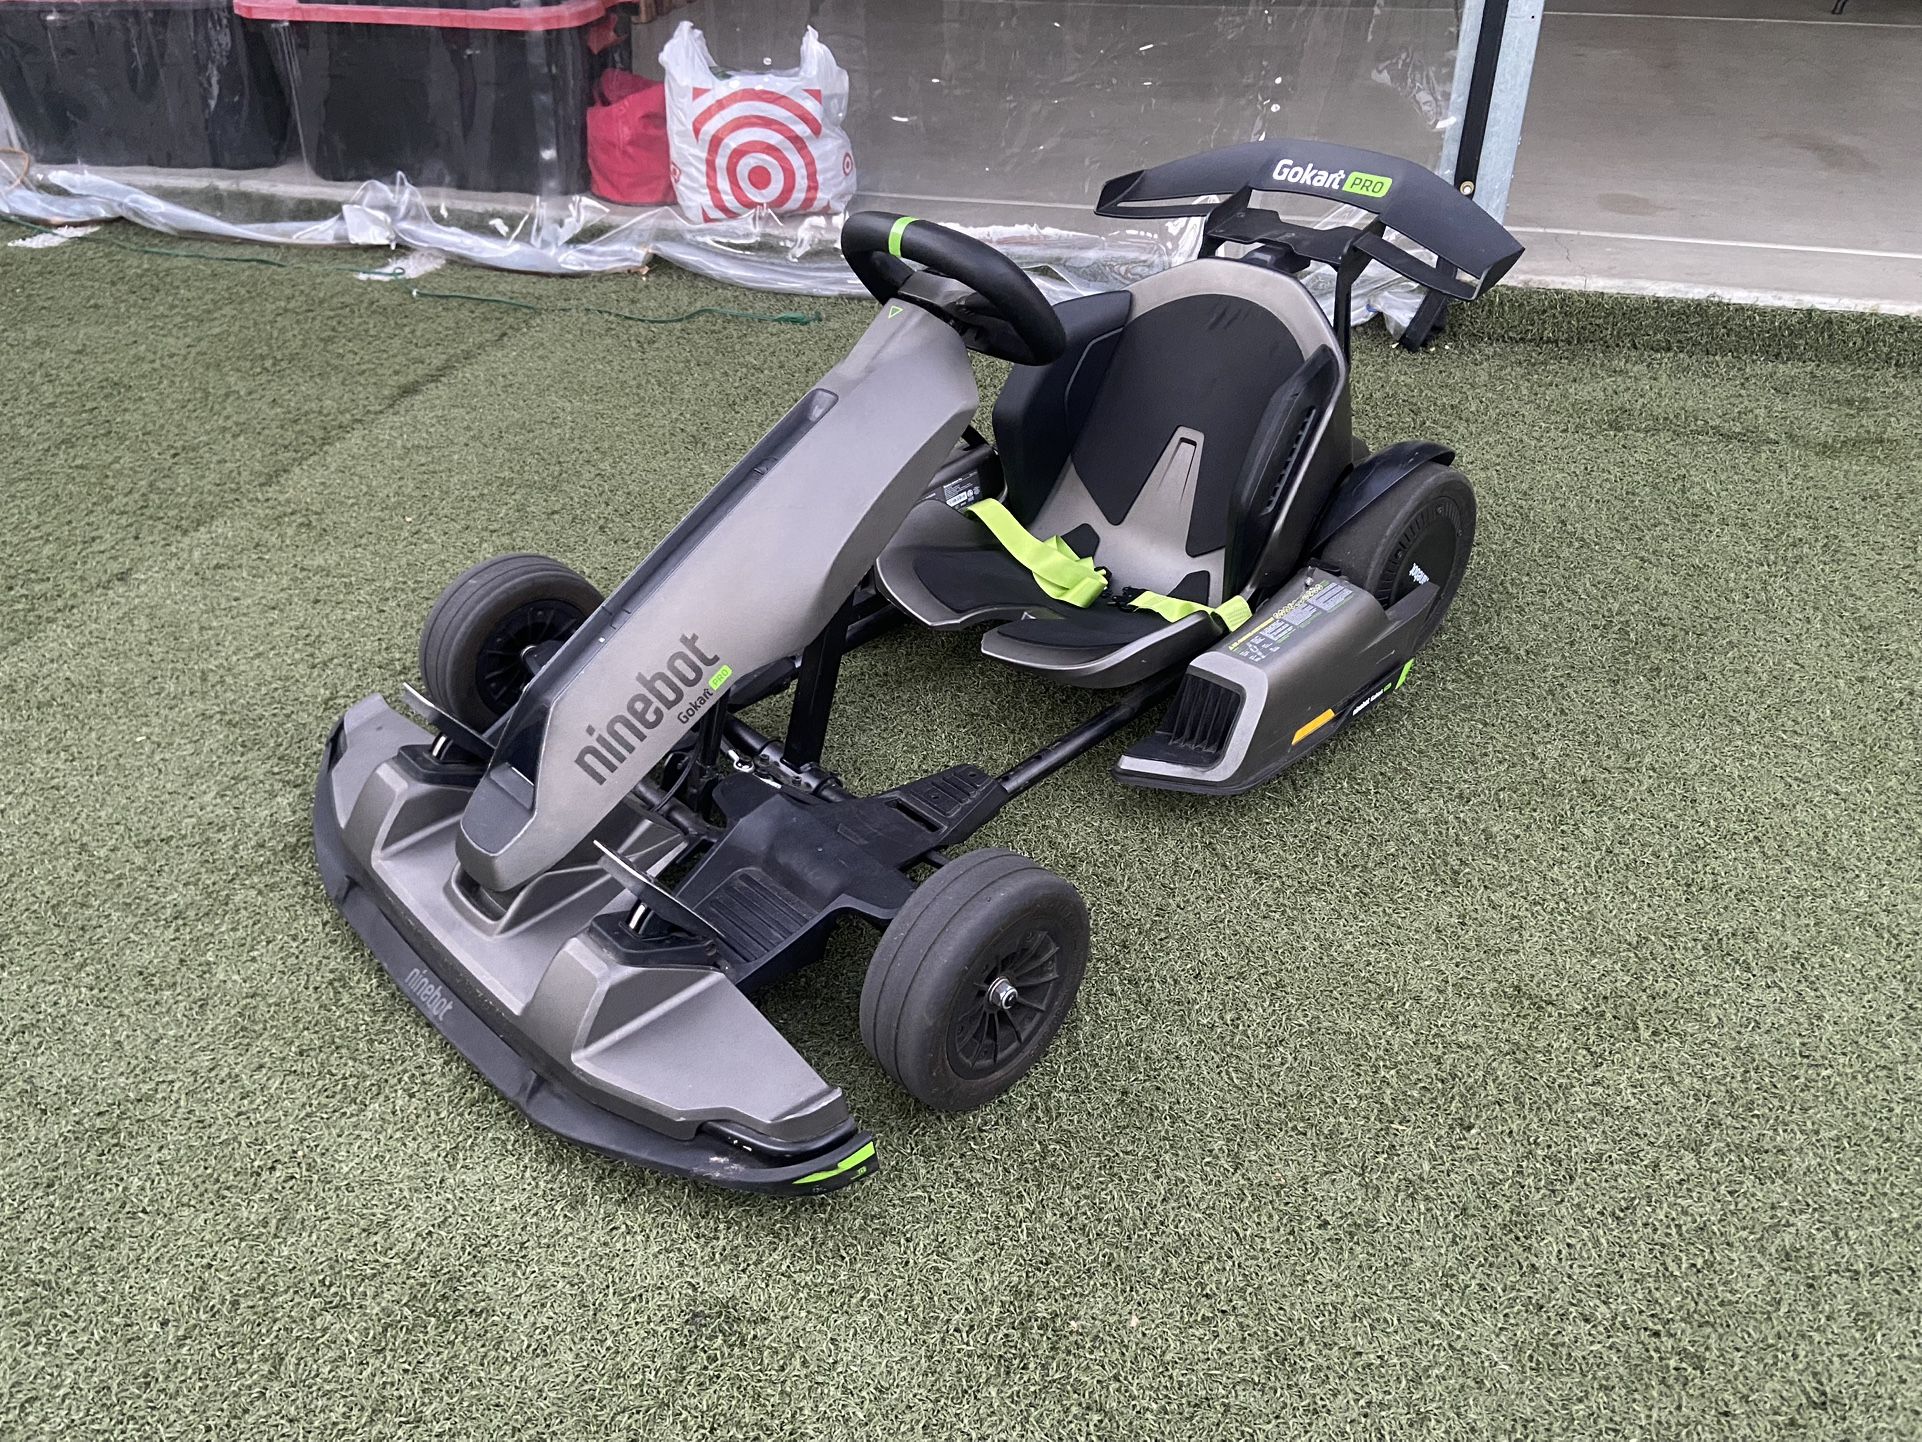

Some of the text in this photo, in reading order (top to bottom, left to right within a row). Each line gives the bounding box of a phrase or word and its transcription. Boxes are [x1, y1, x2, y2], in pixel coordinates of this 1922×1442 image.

[1272, 158, 1387, 195] Gokart PRO
[574, 632, 720, 786] ninebot
[677, 667, 730, 725] Gokart PRO
[404, 967, 454, 1021] ninebot
